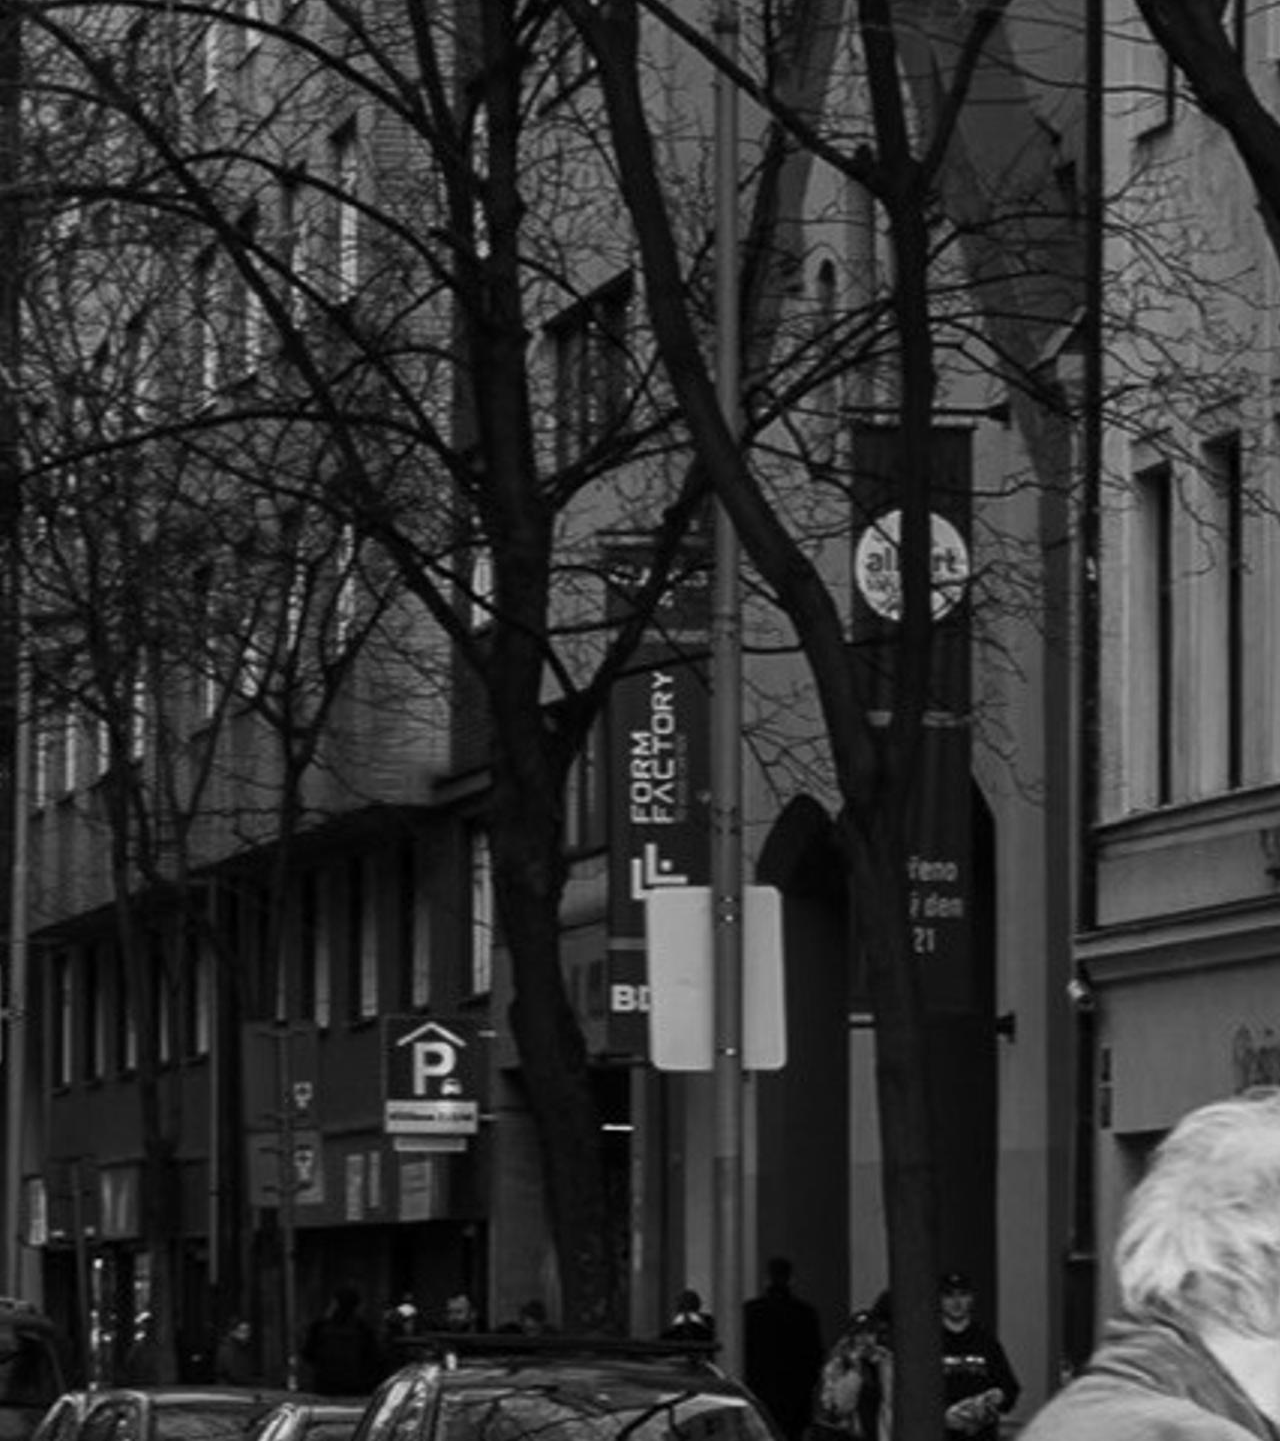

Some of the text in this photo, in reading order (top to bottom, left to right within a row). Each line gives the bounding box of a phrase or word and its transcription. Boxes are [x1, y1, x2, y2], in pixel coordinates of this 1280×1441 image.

[631, 730, 653, 823] FORM
[652, 670, 676, 823] FACTORY
[413, 1041, 456, 1096] P
